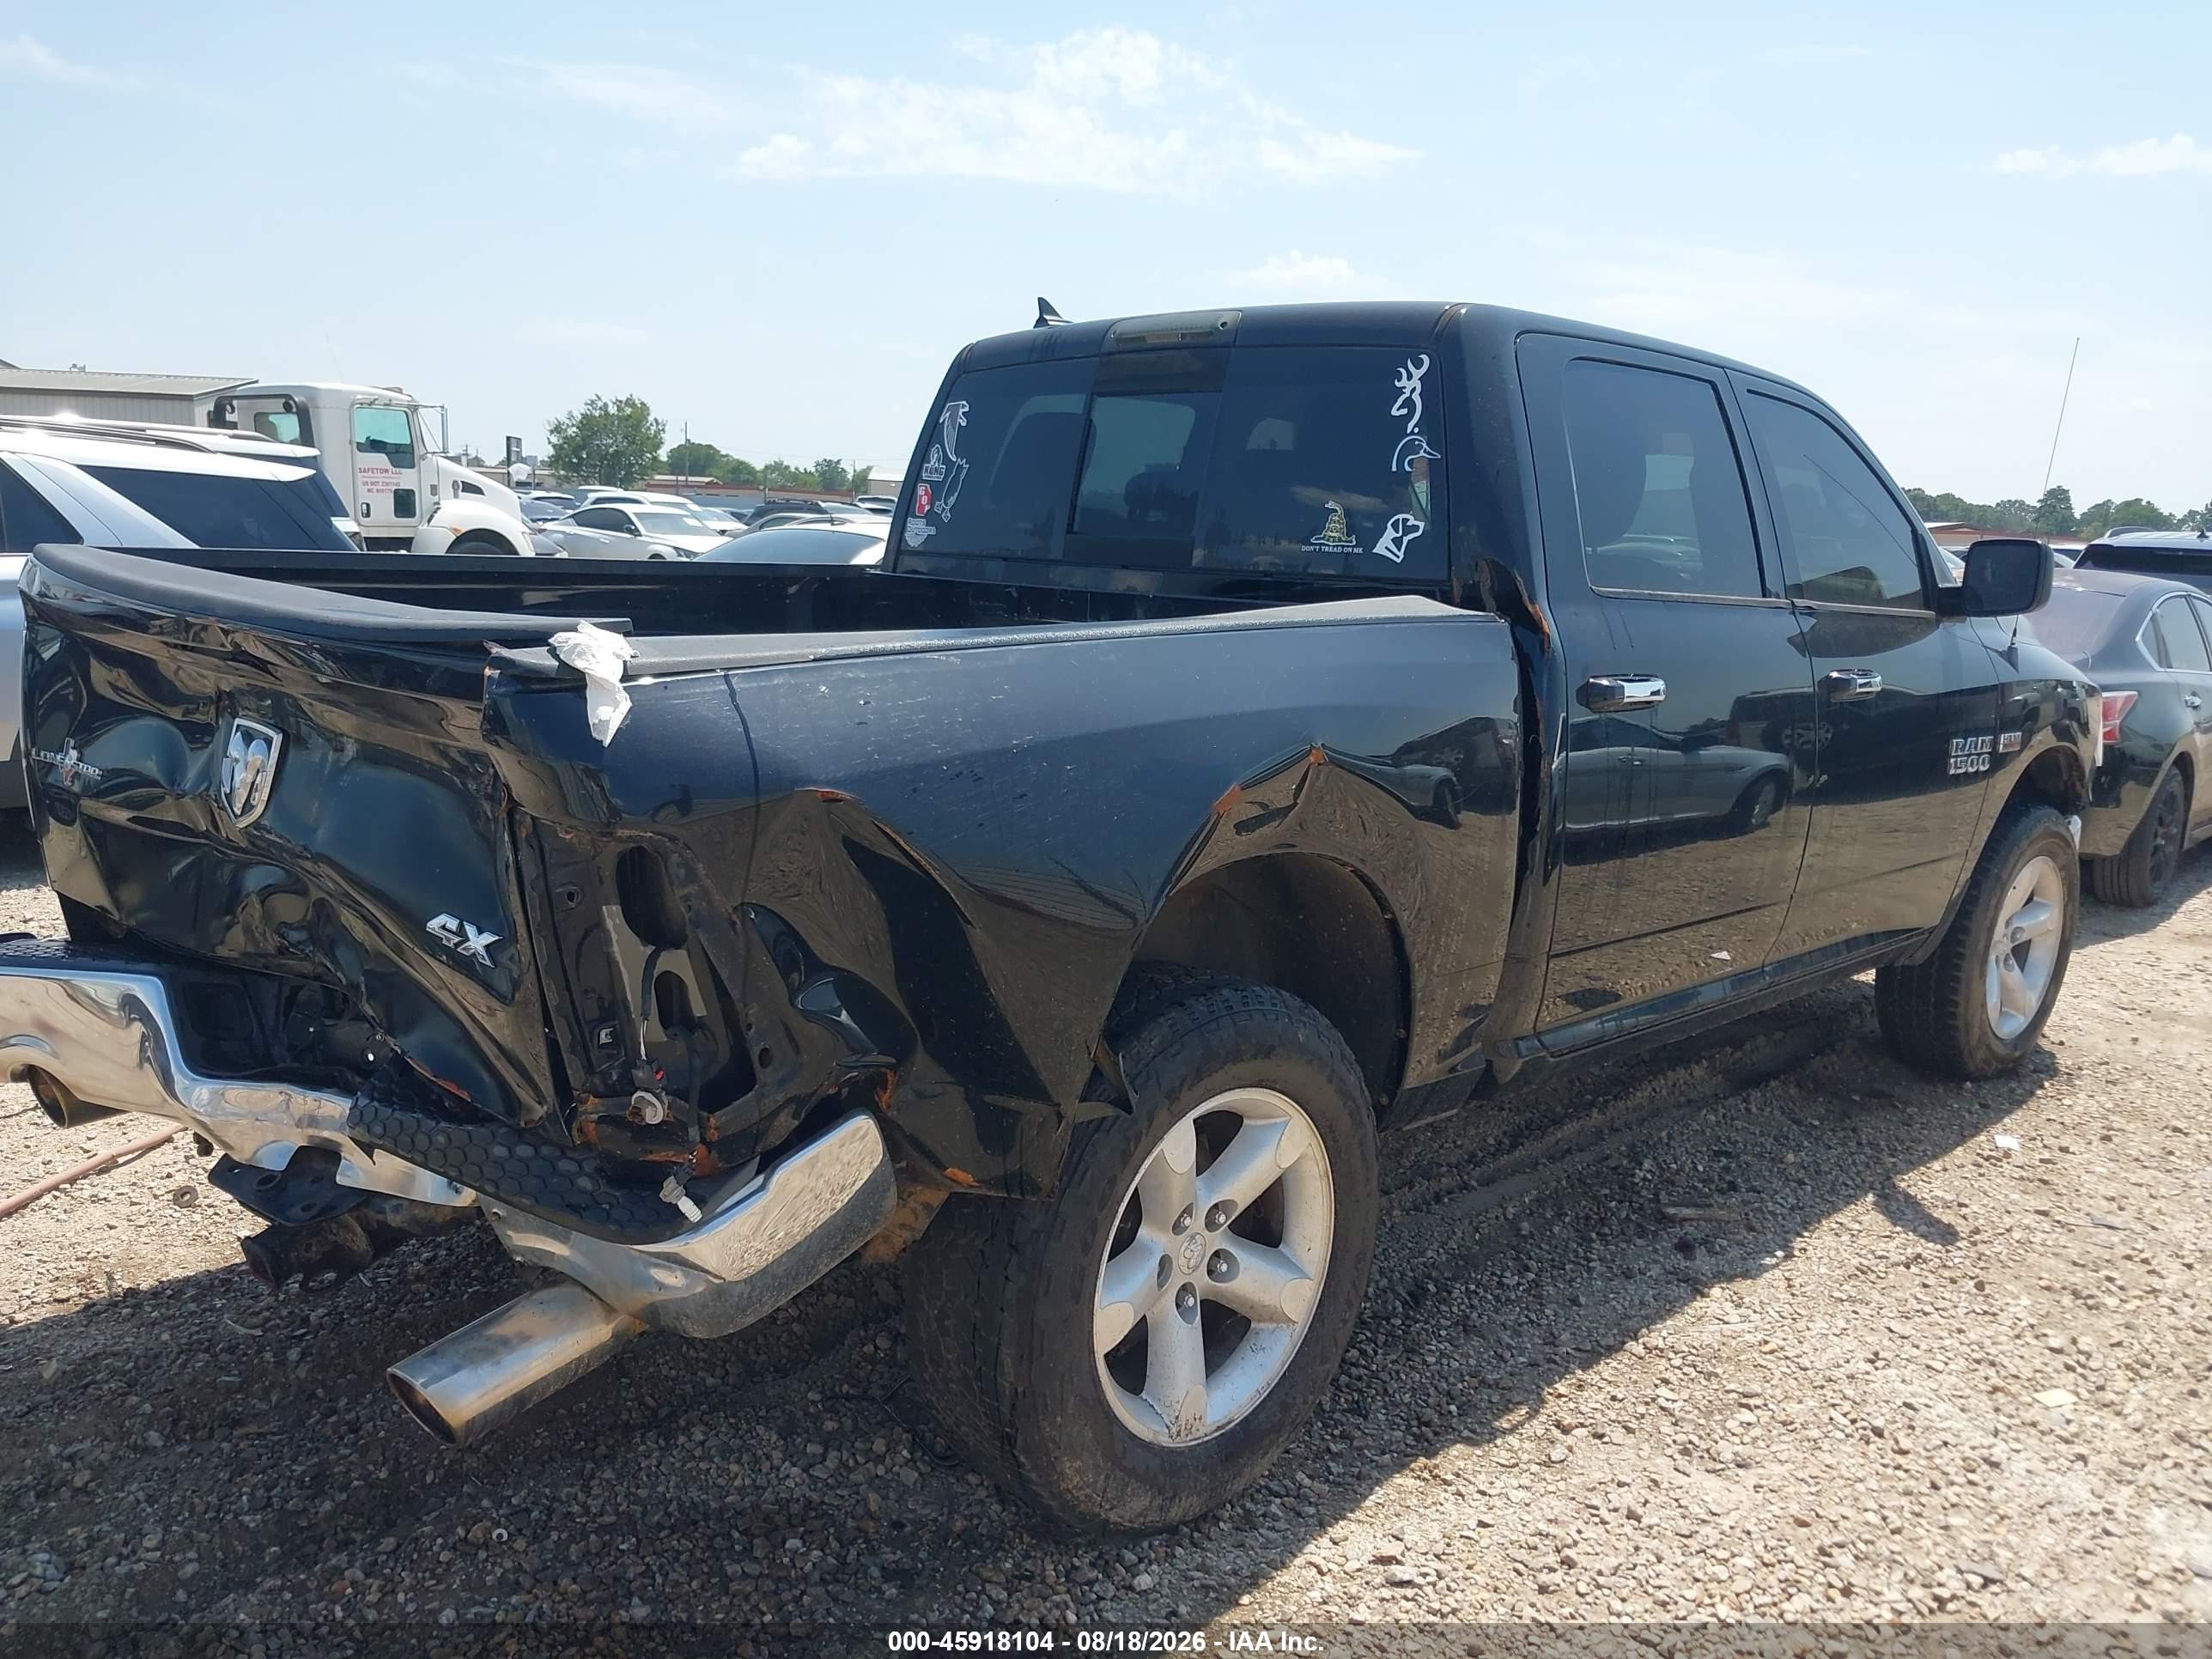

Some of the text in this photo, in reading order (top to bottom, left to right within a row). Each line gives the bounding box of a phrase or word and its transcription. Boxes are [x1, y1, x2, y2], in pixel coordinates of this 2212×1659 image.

[924, 465, 945, 476] KONG
[1951, 736, 1994, 756] RAM
[1949, 754, 1991, 775] 1500
